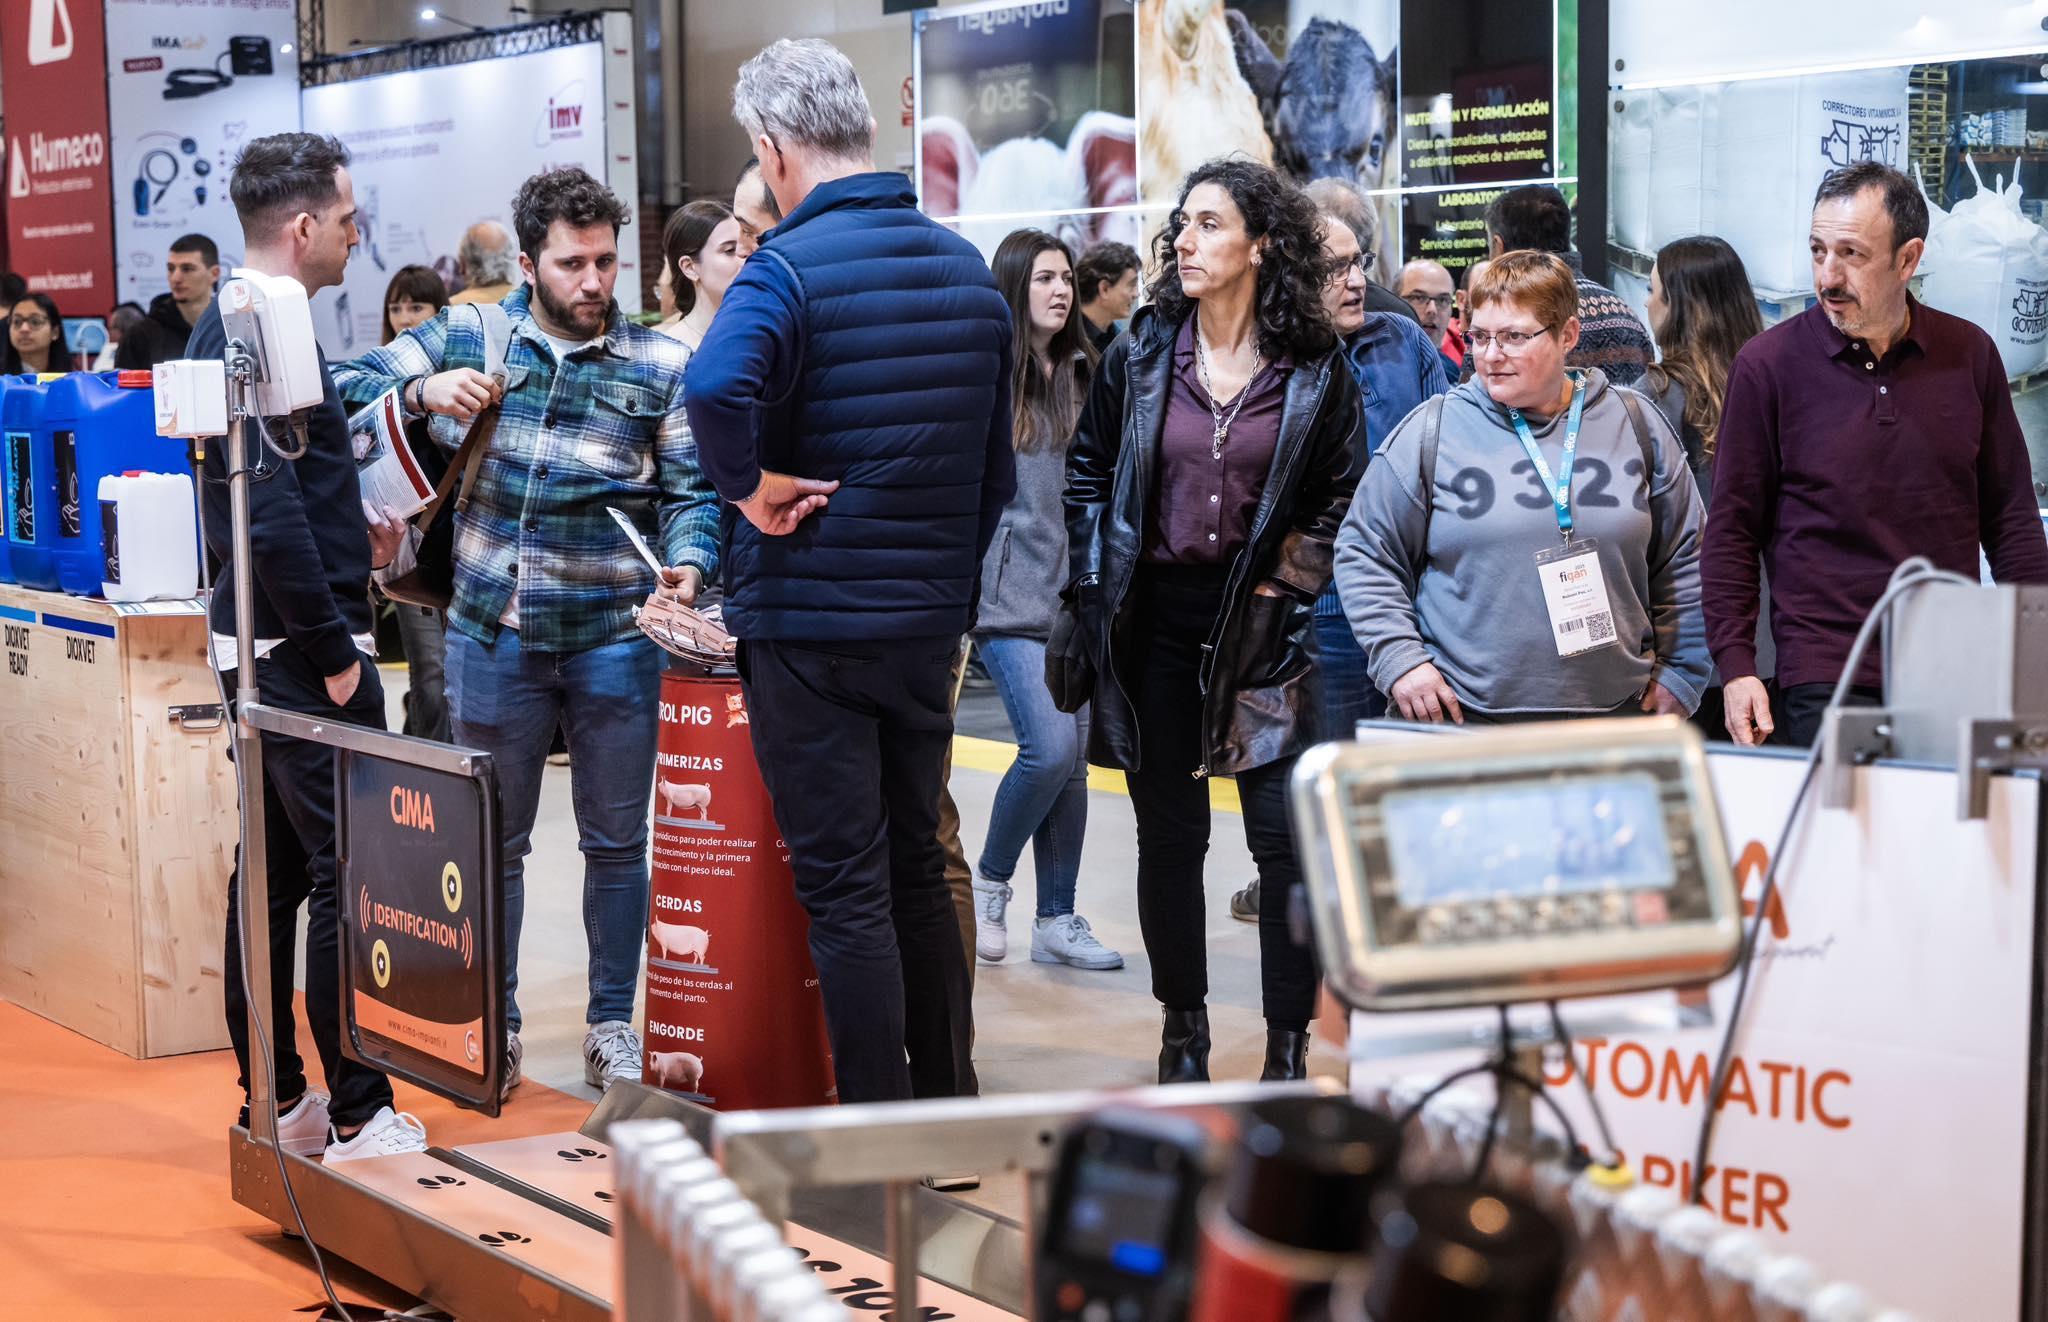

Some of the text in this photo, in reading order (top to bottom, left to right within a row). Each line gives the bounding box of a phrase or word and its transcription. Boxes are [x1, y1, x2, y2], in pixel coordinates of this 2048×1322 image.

[549, 98, 582, 129] imv
[1462, 108, 1470, 121] Y
[1471, 99, 1550, 121] FORMULACIÓN
[1822, 100, 1867, 118] CORRECTORES
[1500, 128, 1548, 145] adaptadas
[30, 132, 104, 173] Humeco
[1453, 151, 1490, 168] especies
[1490, 149, 1503, 163] de
[1504, 146, 1547, 162] animales.
[1420, 236, 1487, 251] Servicio externo
[1559, 568, 1588, 583] figan
[5, 624, 30, 651] DIOXVET
[66, 635, 95, 665] DIOXVET
[9, 651, 29, 677] READY
[658, 700, 713, 726] ROL PIG
[656, 752, 724, 771] PRIMERIZAS
[391, 785, 436, 833] CIMA
[679, 836, 696, 846] para
[697, 837, 721, 848] poder
[723, 837, 758, 848] realizar
[706, 851, 714, 861] la
[715, 852, 751, 864] primera
[670, 864, 682, 873] con
[682, 864, 690, 874] el
[691, 866, 710, 877] peso
[711, 867, 735, 877] ideal.
[655, 895, 703, 913] CERDAS
[374, 901, 459, 951] IDENTIFICATION
[659, 975, 673, 986] peso
[673, 976, 683, 986] de
[683, 978, 694, 988] las
[695, 979, 723, 990] cerdas
[724, 981, 733, 991] al
[672, 989, 683, 1001] del
[684, 992, 708, 1005] parto.
[649, 1020, 705, 1042] ENGORDE
